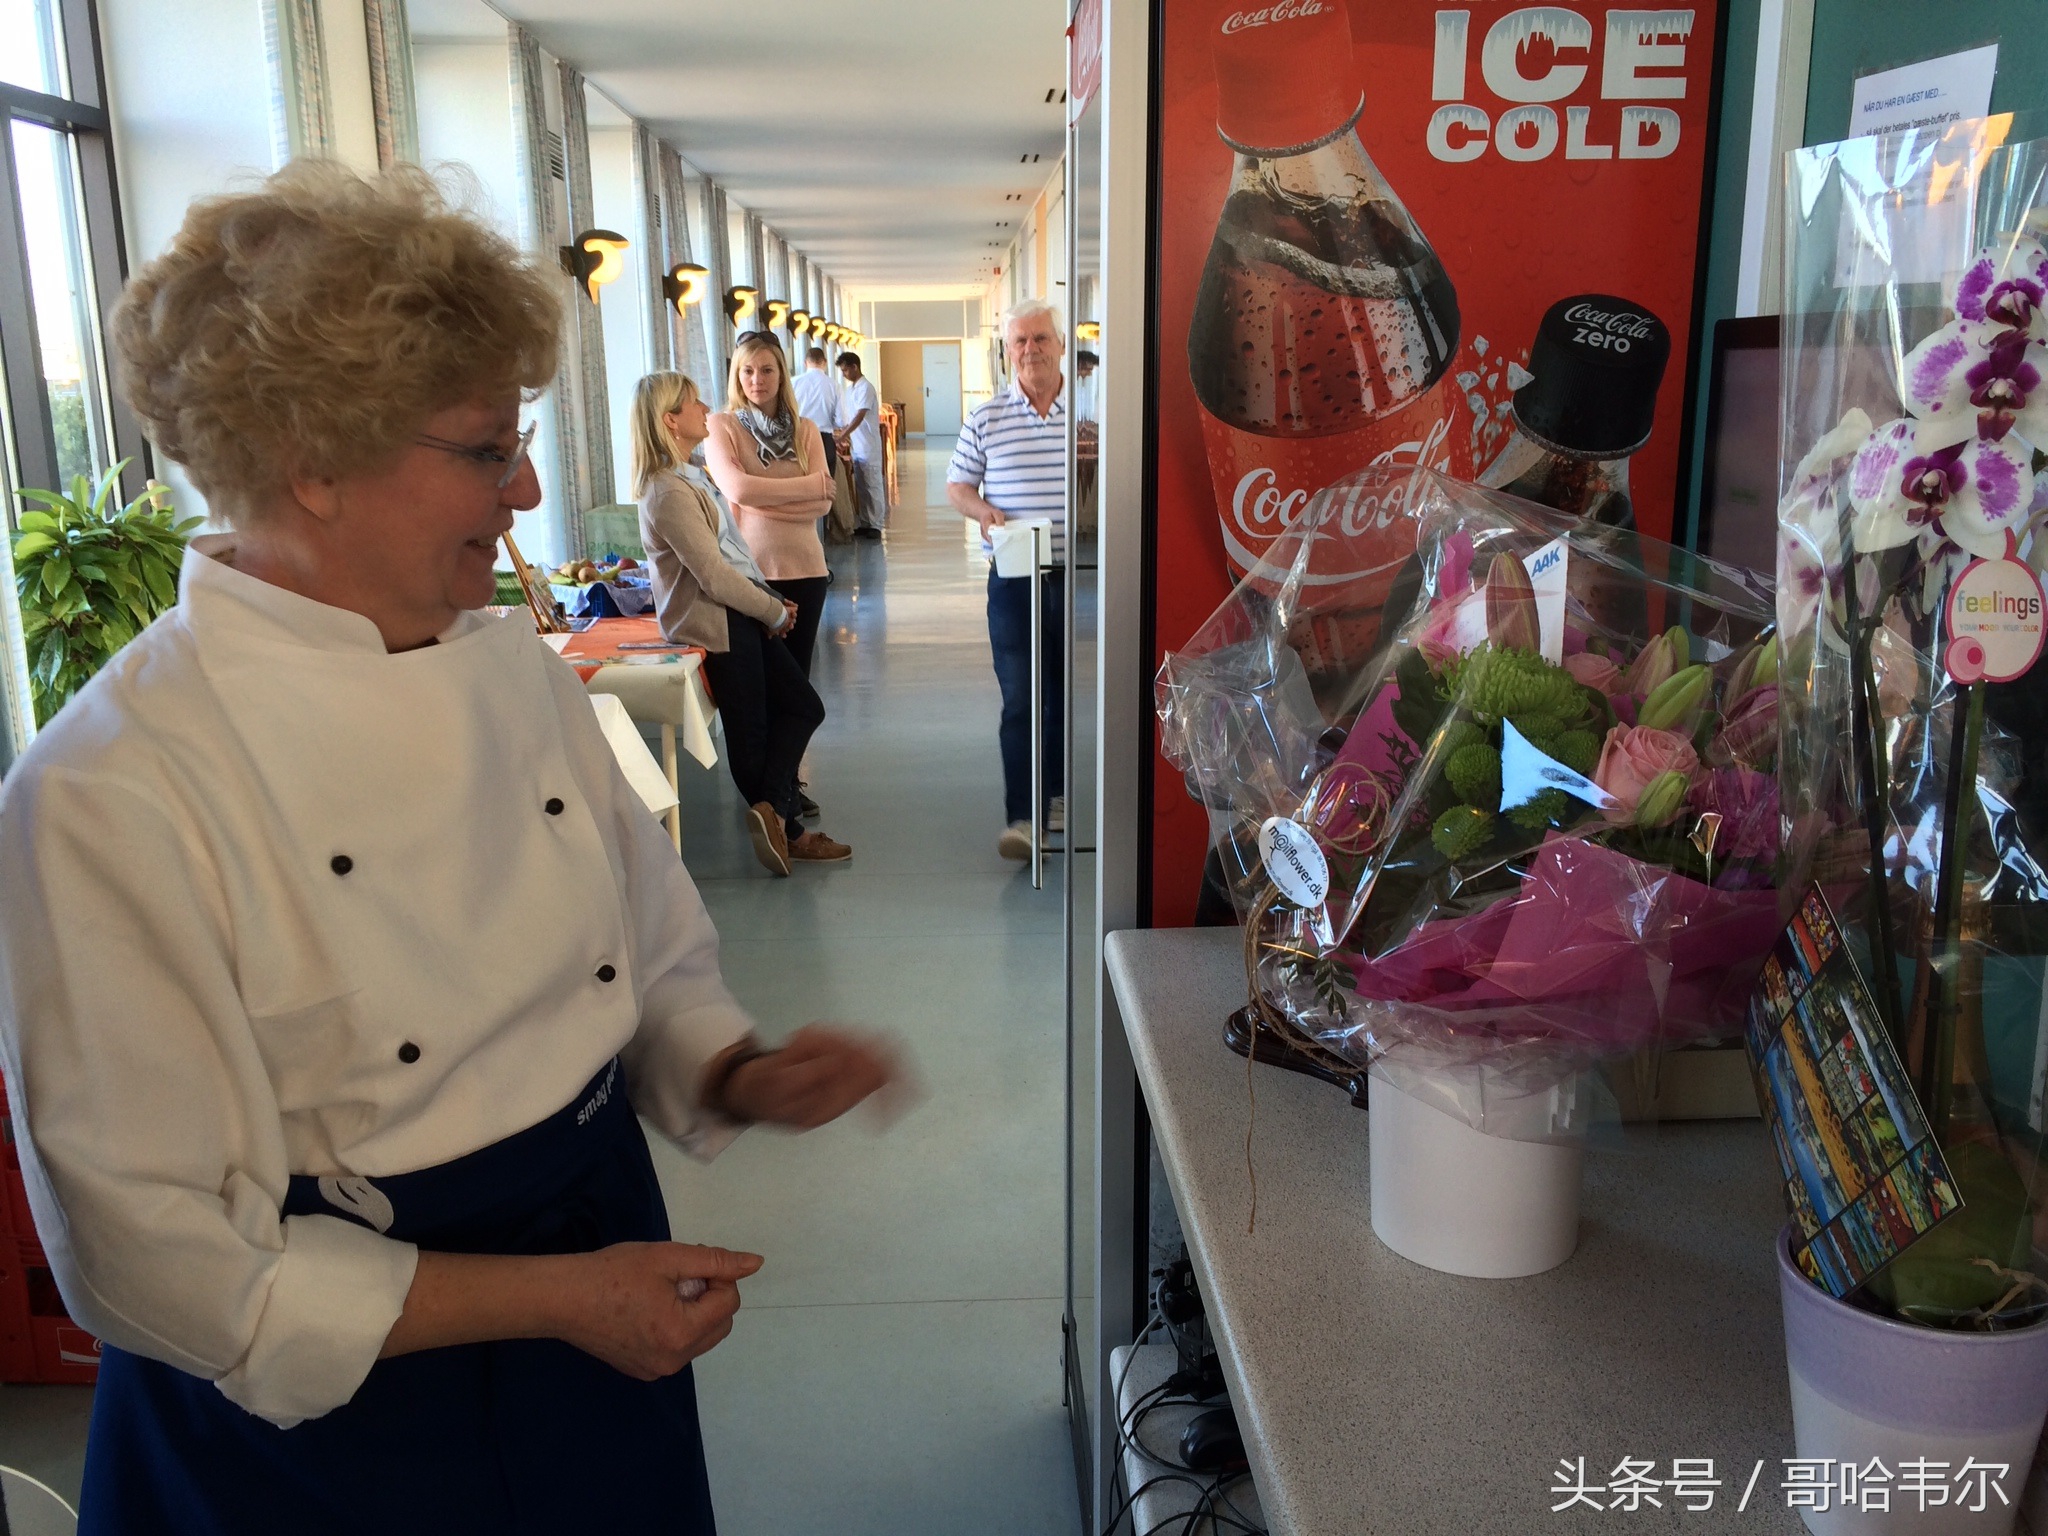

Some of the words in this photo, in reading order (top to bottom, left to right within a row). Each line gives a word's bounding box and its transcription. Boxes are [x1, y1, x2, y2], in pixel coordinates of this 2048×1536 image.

[1221, 0, 1322, 34] Coca-Cola
[1432, 6, 1696, 103] ICE
[1863, 100, 1875, 112] NÅR
[1875, 101, 1884, 111] DU
[1884, 97, 1897, 108] HAR
[1897, 95, 1906, 106] EN
[1906, 91, 1924, 104] GÆST
[1426, 104, 1681, 162] COLD
[1883, 125, 1892, 134] der
[1892, 121, 1910, 132] betales
[1564, 303, 1656, 339] Coca-Cola
[1572, 327, 1631, 353] zero
[1531, 546, 1561, 578] AAK
[1957, 590, 2040, 620] feelings
[1268, 825, 1323, 900] m@ilflower.dk
